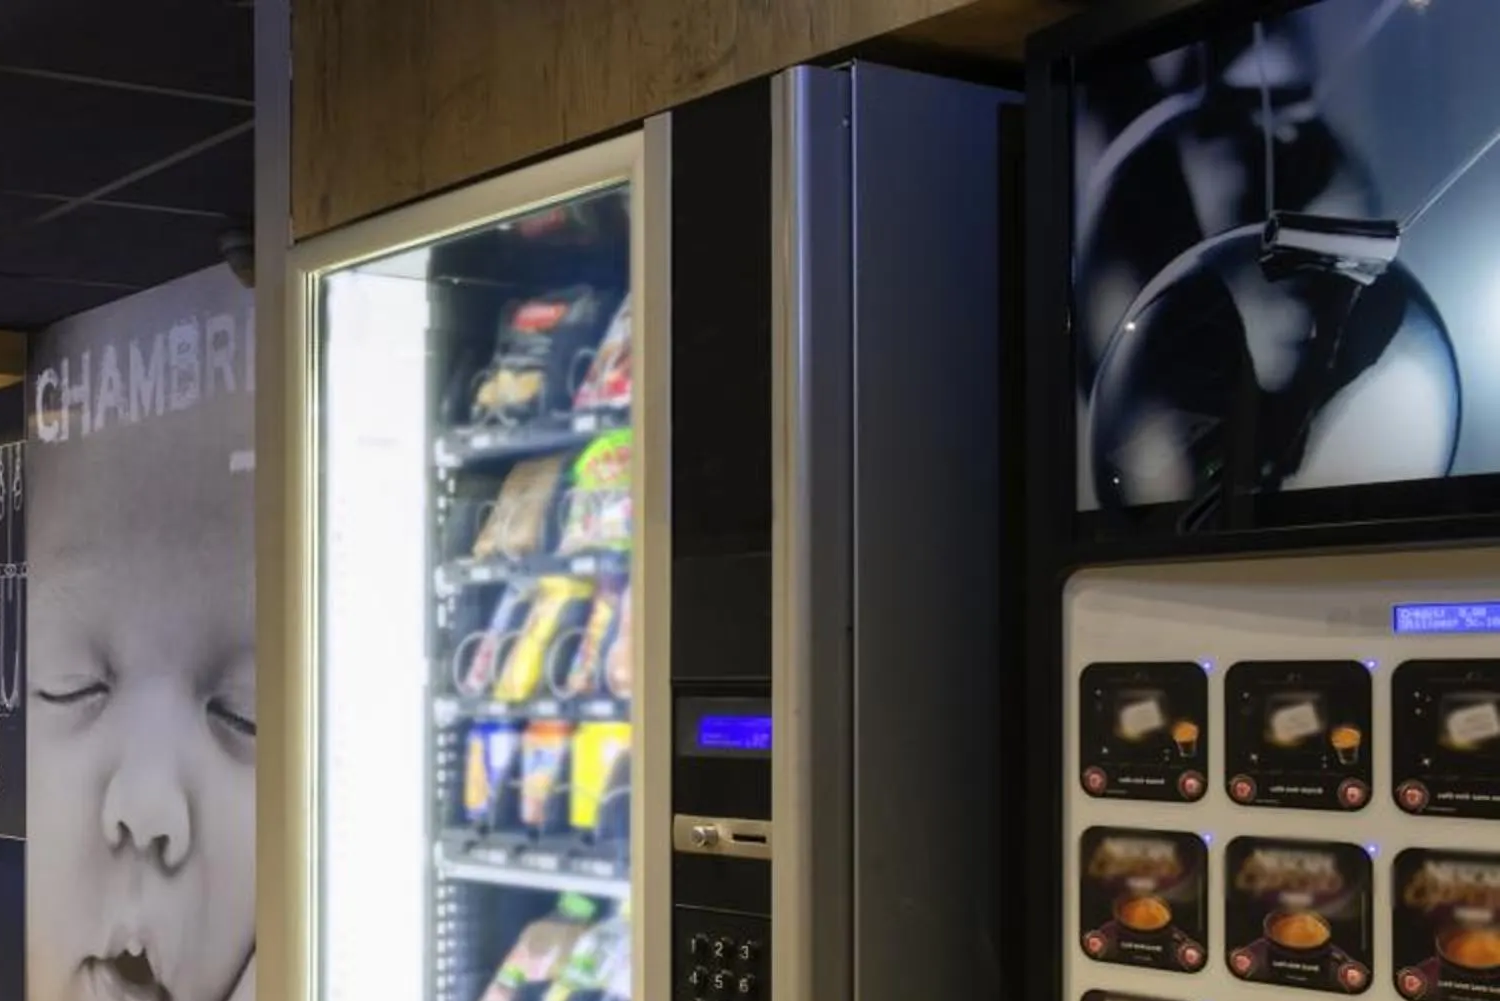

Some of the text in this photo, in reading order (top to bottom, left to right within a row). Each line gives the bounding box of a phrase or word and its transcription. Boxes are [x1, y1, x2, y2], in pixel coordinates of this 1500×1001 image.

[714, 941, 724, 957] 2
[739, 945, 749, 960] 3
[714, 973, 724, 989] 5
[739, 978, 749, 993] 6
